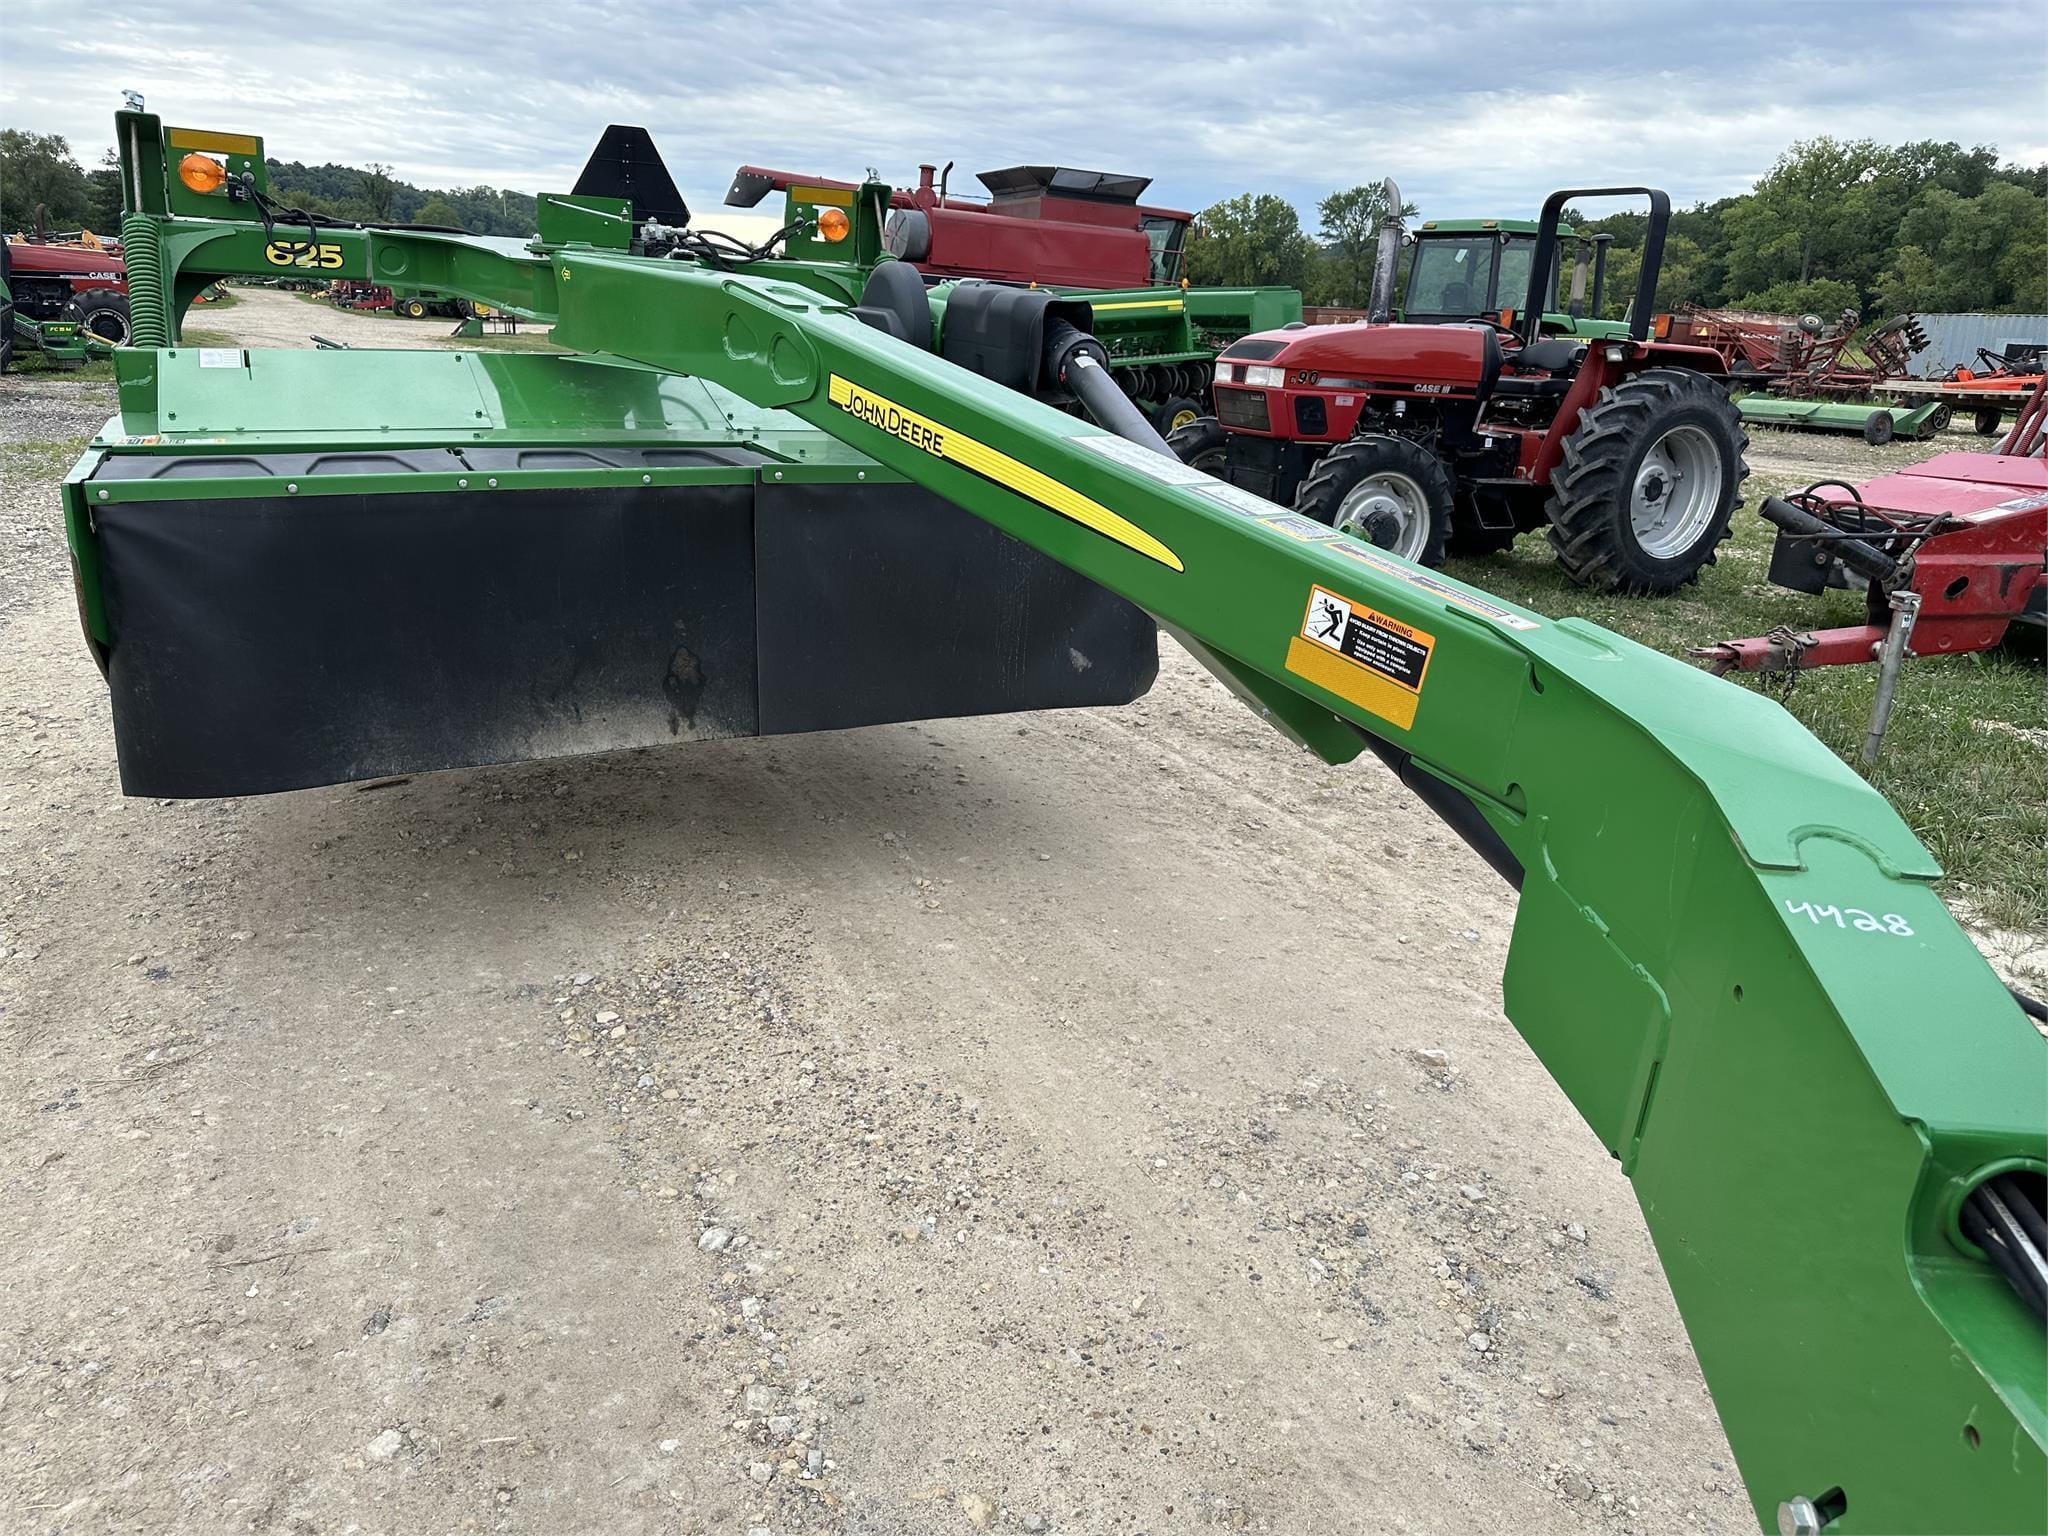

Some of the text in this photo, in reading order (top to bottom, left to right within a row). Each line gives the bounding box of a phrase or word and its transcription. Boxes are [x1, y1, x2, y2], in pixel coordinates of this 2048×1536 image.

[265, 240, 344, 270] 625
[89, 271, 117, 280] CASE
[1414, 383, 1440, 393] CASE
[844, 389, 944, 455] JOHN DEERE
[1376, 616, 1412, 637] WARNING
[1785, 899, 1915, 937] 4428
